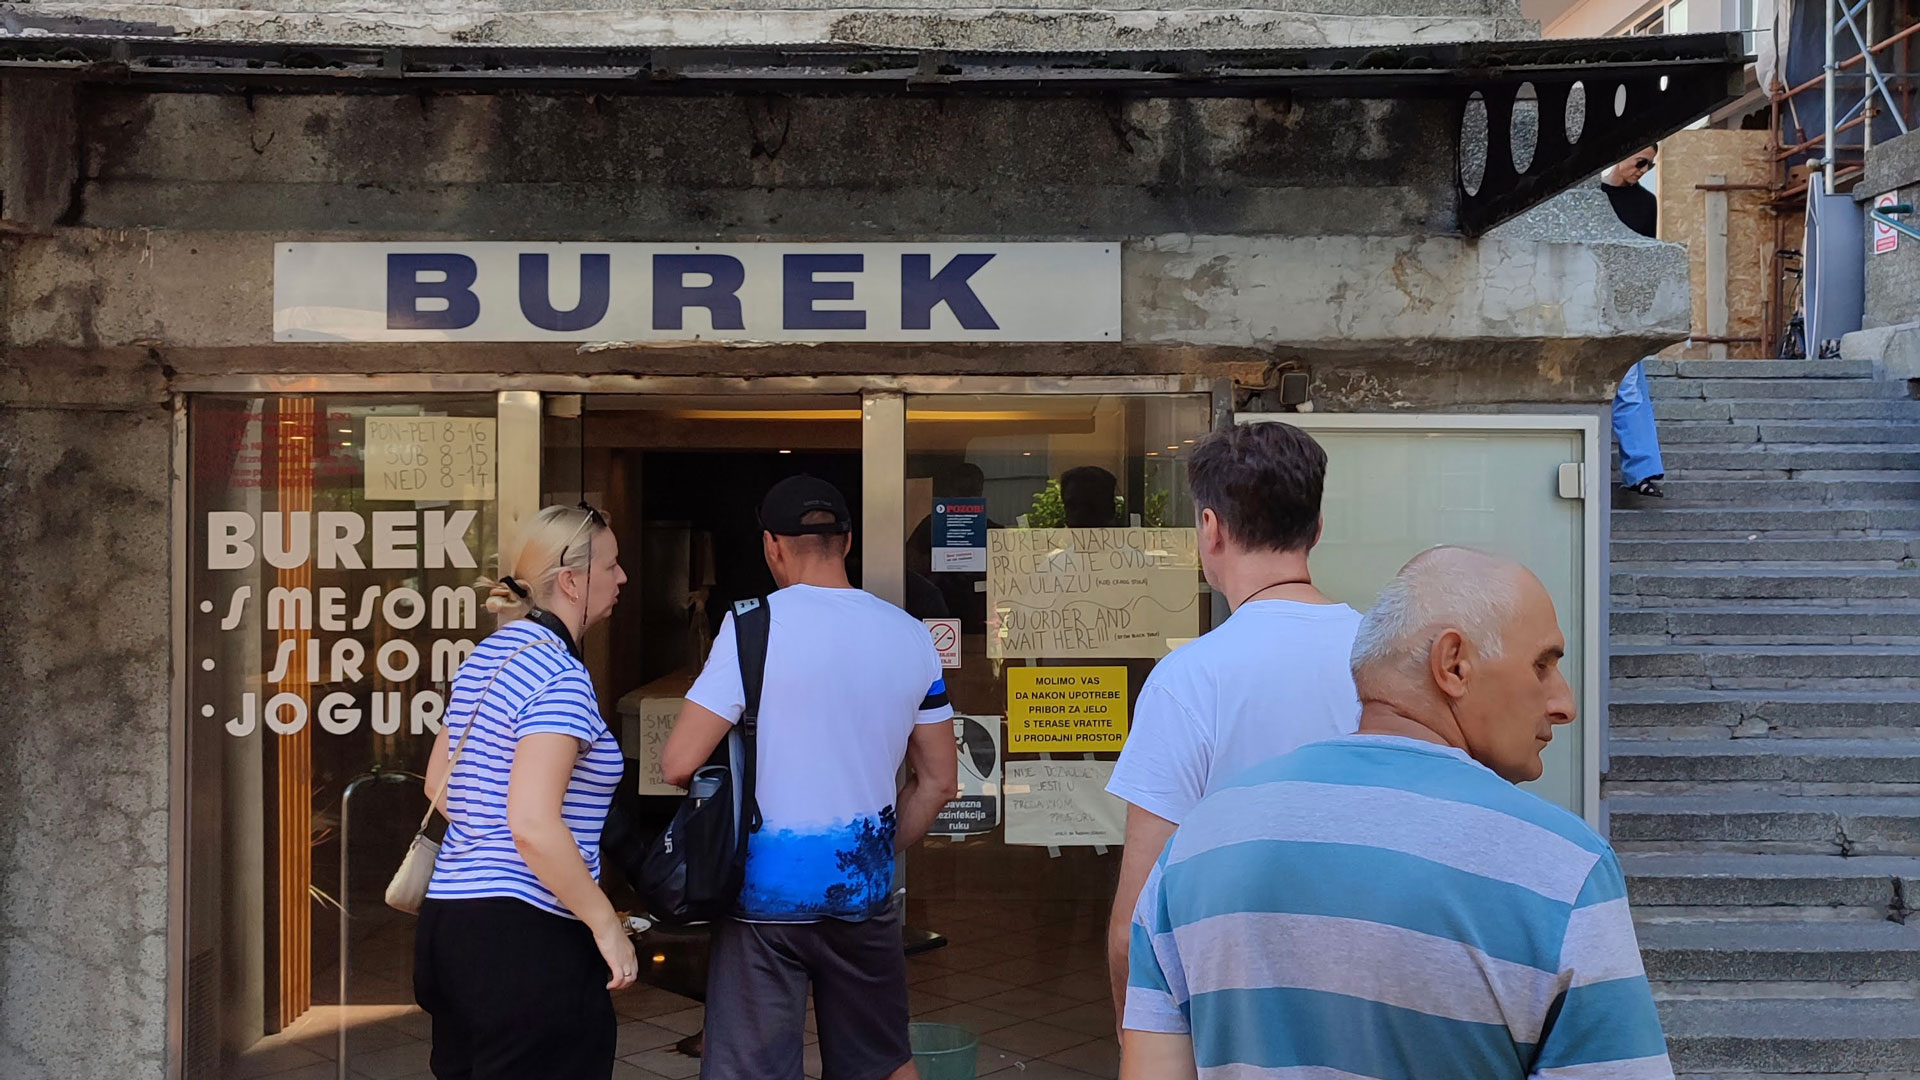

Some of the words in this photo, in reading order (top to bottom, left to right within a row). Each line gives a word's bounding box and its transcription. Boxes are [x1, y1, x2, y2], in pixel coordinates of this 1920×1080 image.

[386, 253, 999, 331] BUREK
[369, 421, 436, 442] PON-PET
[386, 444, 429, 466] SUB
[384, 468, 427, 490] NED
[207, 510, 478, 570] BUREK
[991, 530, 1058, 553] BUREK
[993, 578, 1022, 597] NA
[1029, 574, 1091, 595] ULAZU
[220, 585, 252, 631] S
[267, 585, 477, 631] MESOM
[1030, 608, 1087, 631] ORDER
[1094, 607, 1131, 630] AND
[1001, 630, 1047, 651] WAIT
[267, 637, 476, 683] SIROM
[1035, 677, 1076, 685] MOLIMO
[1080, 677, 1100, 685] VAS
[1015, 691, 1029, 700] DA
[1031, 691, 1066, 700] NAKON
[1068, 691, 1121, 699] UPOTREBE
[225, 691, 444, 737] JOGUR
[1028, 705, 1066, 714] PRIBOR
[1068, 705, 1081, 714] ZA
[1083, 705, 1108, 714] JELO
[1023, 719, 1031, 728] S
[1033, 719, 1071, 728] TERASE
[1073, 719, 1113, 728] VRATITE
[1014, 734, 1021, 742] U
[1023, 733, 1073, 743] PRODAJNI
[1075, 733, 1122, 742] PROSTOR
[936, 810, 987, 822] ezinfekcija
[948, 822, 970, 830] ruku
